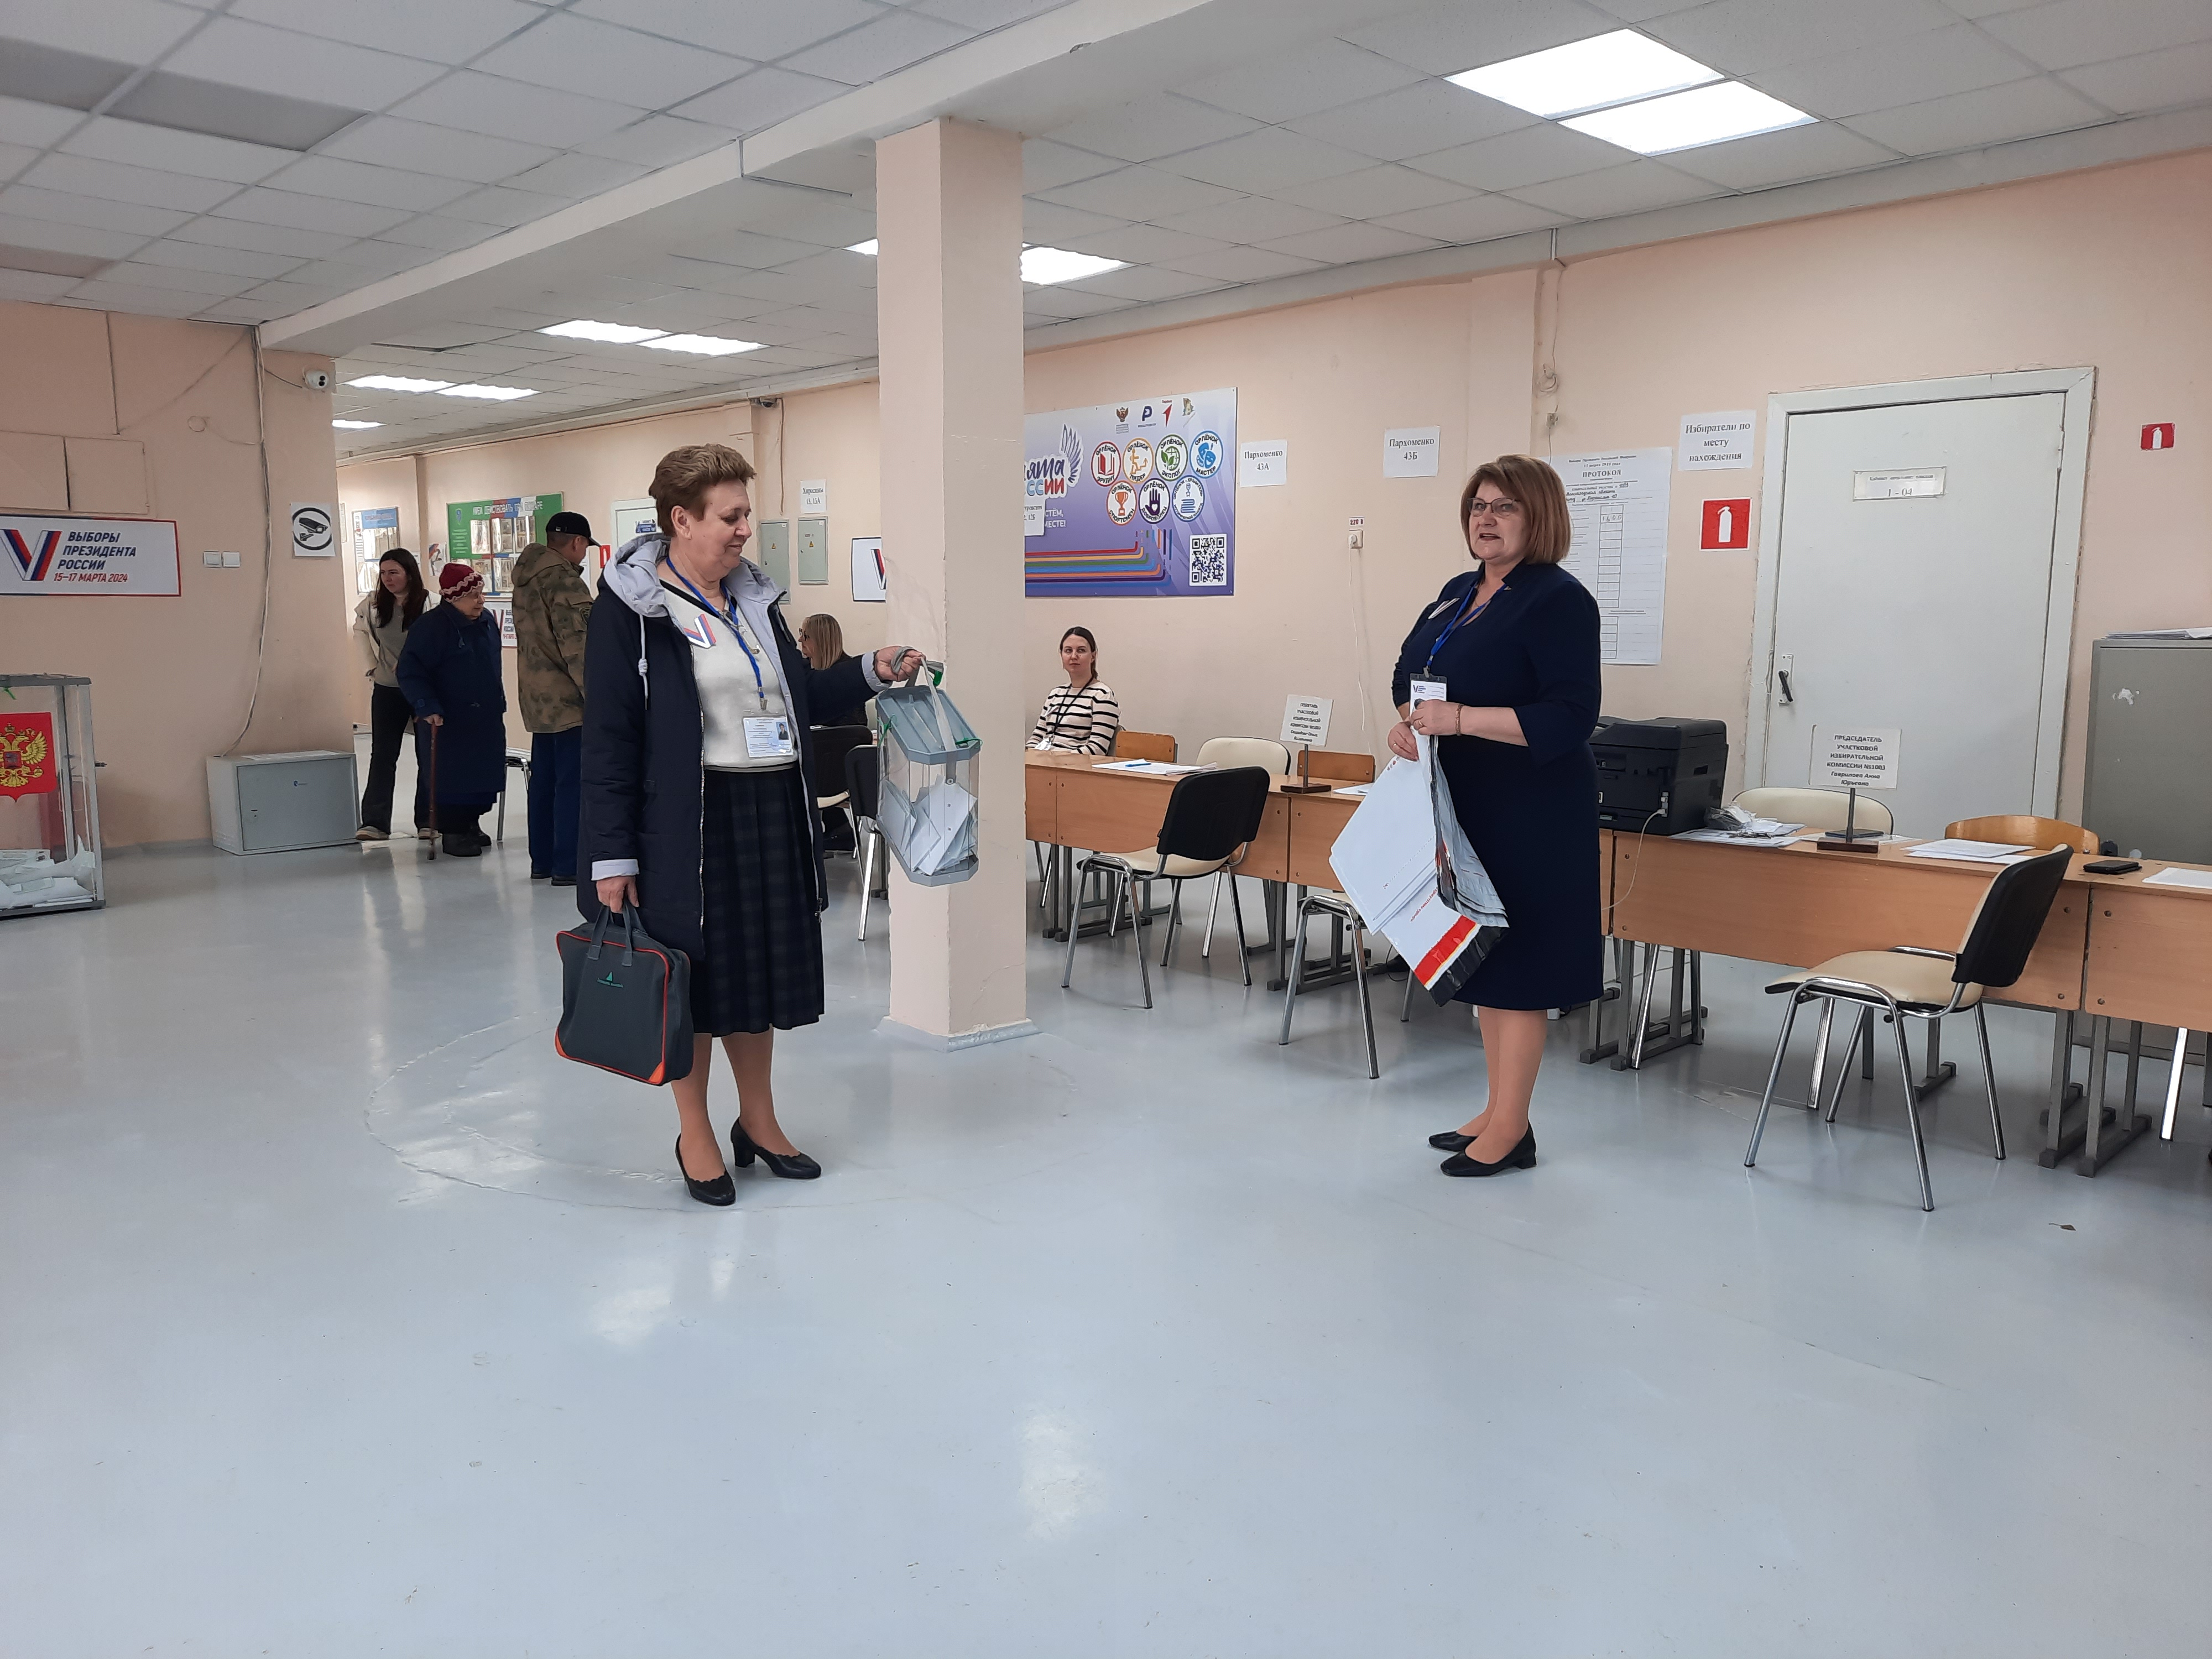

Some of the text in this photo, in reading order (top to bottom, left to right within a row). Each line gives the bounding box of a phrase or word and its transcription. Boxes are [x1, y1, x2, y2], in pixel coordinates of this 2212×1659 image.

[1686, 424, 1737, 434] Избиратели
[1161, 437, 1183, 449] ОРЛЁНОК
[1195, 434, 1219, 445] ОРЛЁНОК
[1389, 439, 1434, 448] Пархоменко
[1703, 439, 1729, 447] месту
[1244, 451, 1283, 460] Пархоменко
[1404, 451, 1417, 460] 43Б
[1689, 453, 1741, 462] нахождения
[1026, 458, 1065, 480] ята
[1162, 468, 1181, 478] ЭКОЛОГ
[1196, 466, 1216, 476] МАСТЕР
[1026, 478, 1065, 496] ССИИ
[1045, 508, 1064, 518] СТЁМ,
[67, 531, 121, 543] ВЫБОРЫ
[62, 545, 137, 557] ПРЕЗИДЕНТА
[58, 559, 106, 570] РОССИИ
[78, 573, 107, 582] МАРТА
[108, 573, 128, 582] 2024
